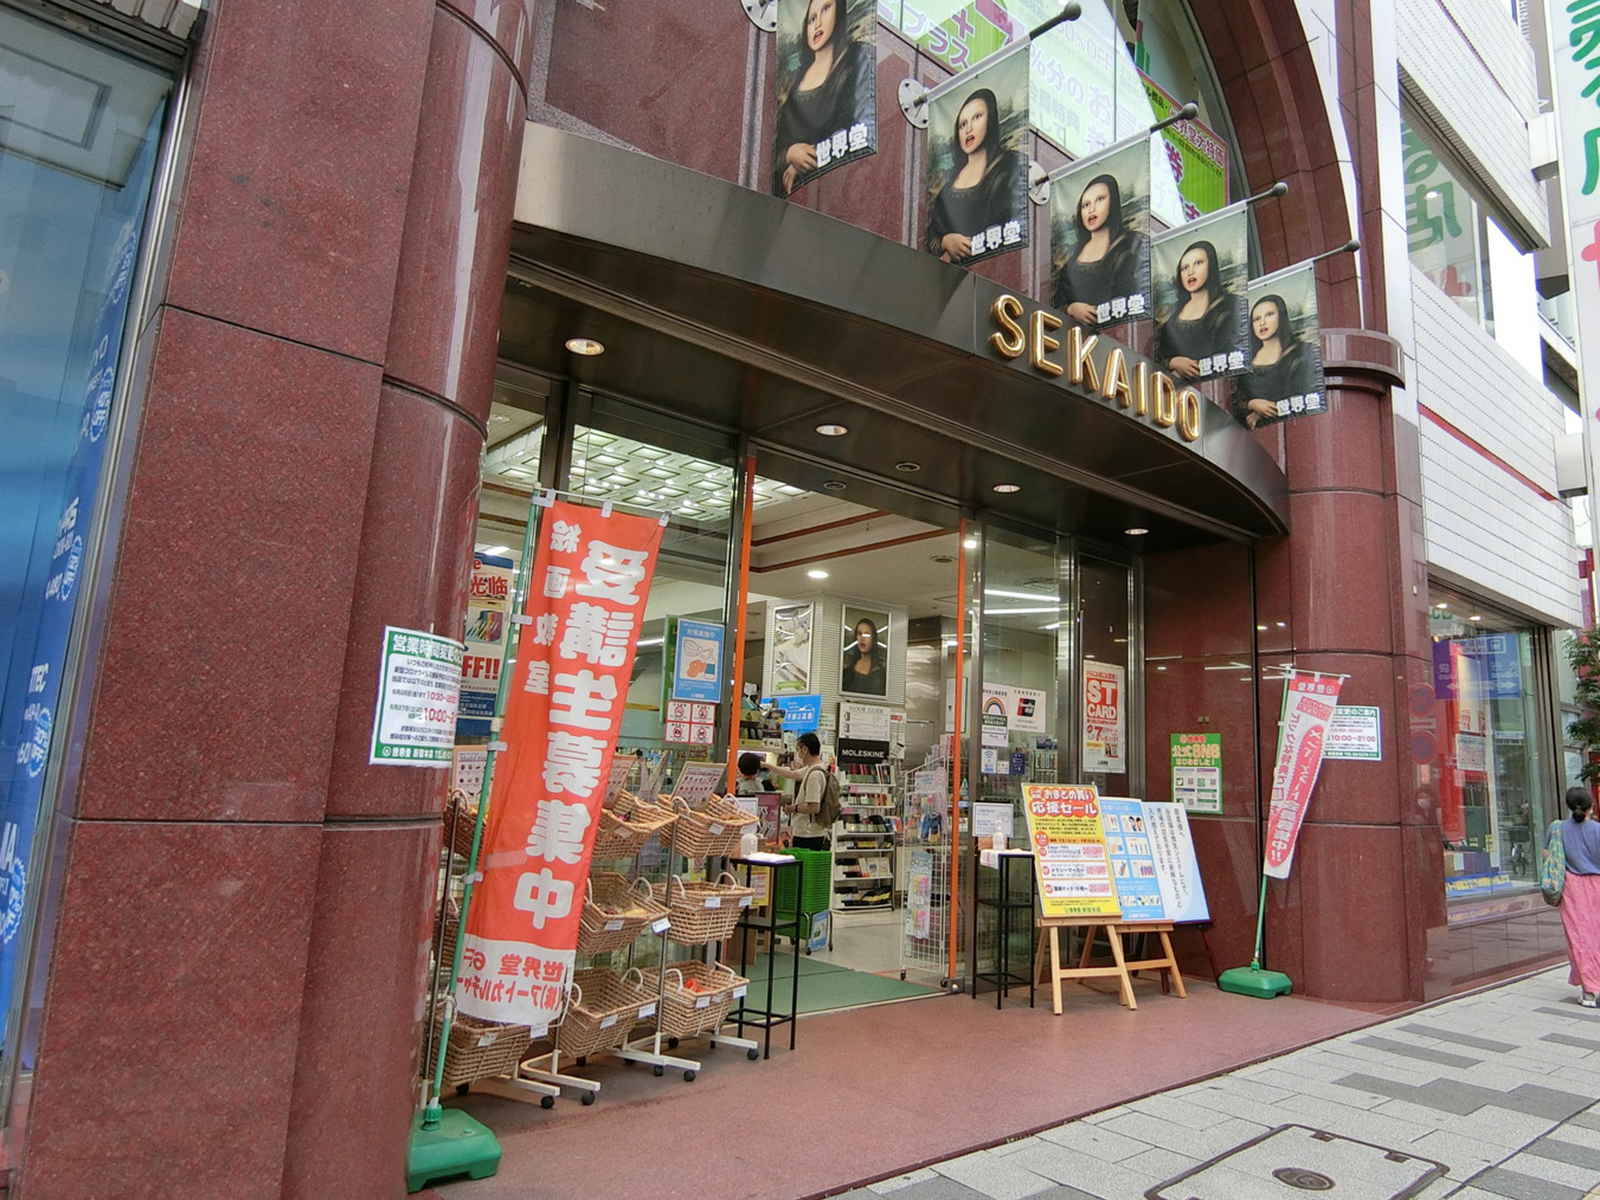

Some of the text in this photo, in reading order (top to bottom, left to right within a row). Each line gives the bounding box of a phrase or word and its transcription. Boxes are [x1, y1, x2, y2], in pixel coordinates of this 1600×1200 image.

[815, 122, 868, 168] 世界堂
[971, 220, 1021, 256] 世界堂
[1096, 293, 1145, 324] 世界堂
[991, 294, 1202, 442] SEKAIDO
[1198, 351, 1245, 377] 世界堂
[1276, 393, 1321, 417] 世界堂
[1087, 680, 1116, 705] ST
[1087, 704, 1117, 719] CARD
[842, 749, 886, 758] MOLESKINE
[1043, 789, 1094, 800] おまとめ買い
[1031, 801, 1097, 814] 応援セール
